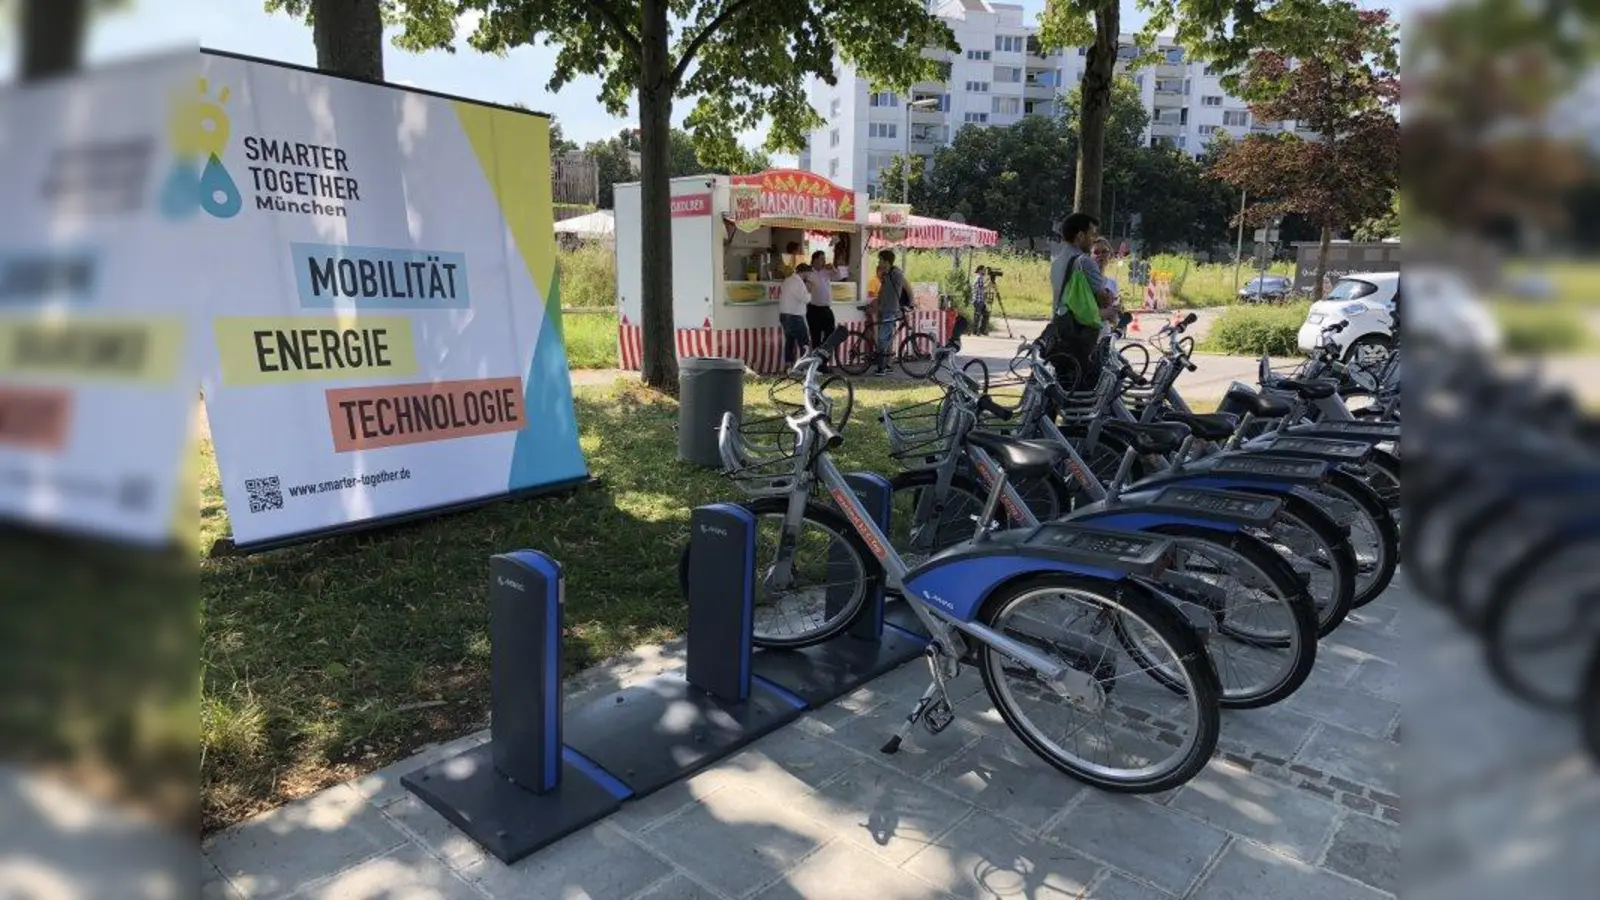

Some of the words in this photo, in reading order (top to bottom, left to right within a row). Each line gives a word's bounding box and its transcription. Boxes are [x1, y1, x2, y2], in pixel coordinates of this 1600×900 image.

[244, 136, 349, 172] SMARTER
[248, 166, 360, 201] TOGETHER
[255, 195, 347, 217] München
[308, 256, 457, 300] MOBILITÄT
[253, 328, 392, 373] ENERGIE
[339, 388, 518, 440] TECHNOLOGIE
[288, 467, 411, 497] www.smarter-together.de
